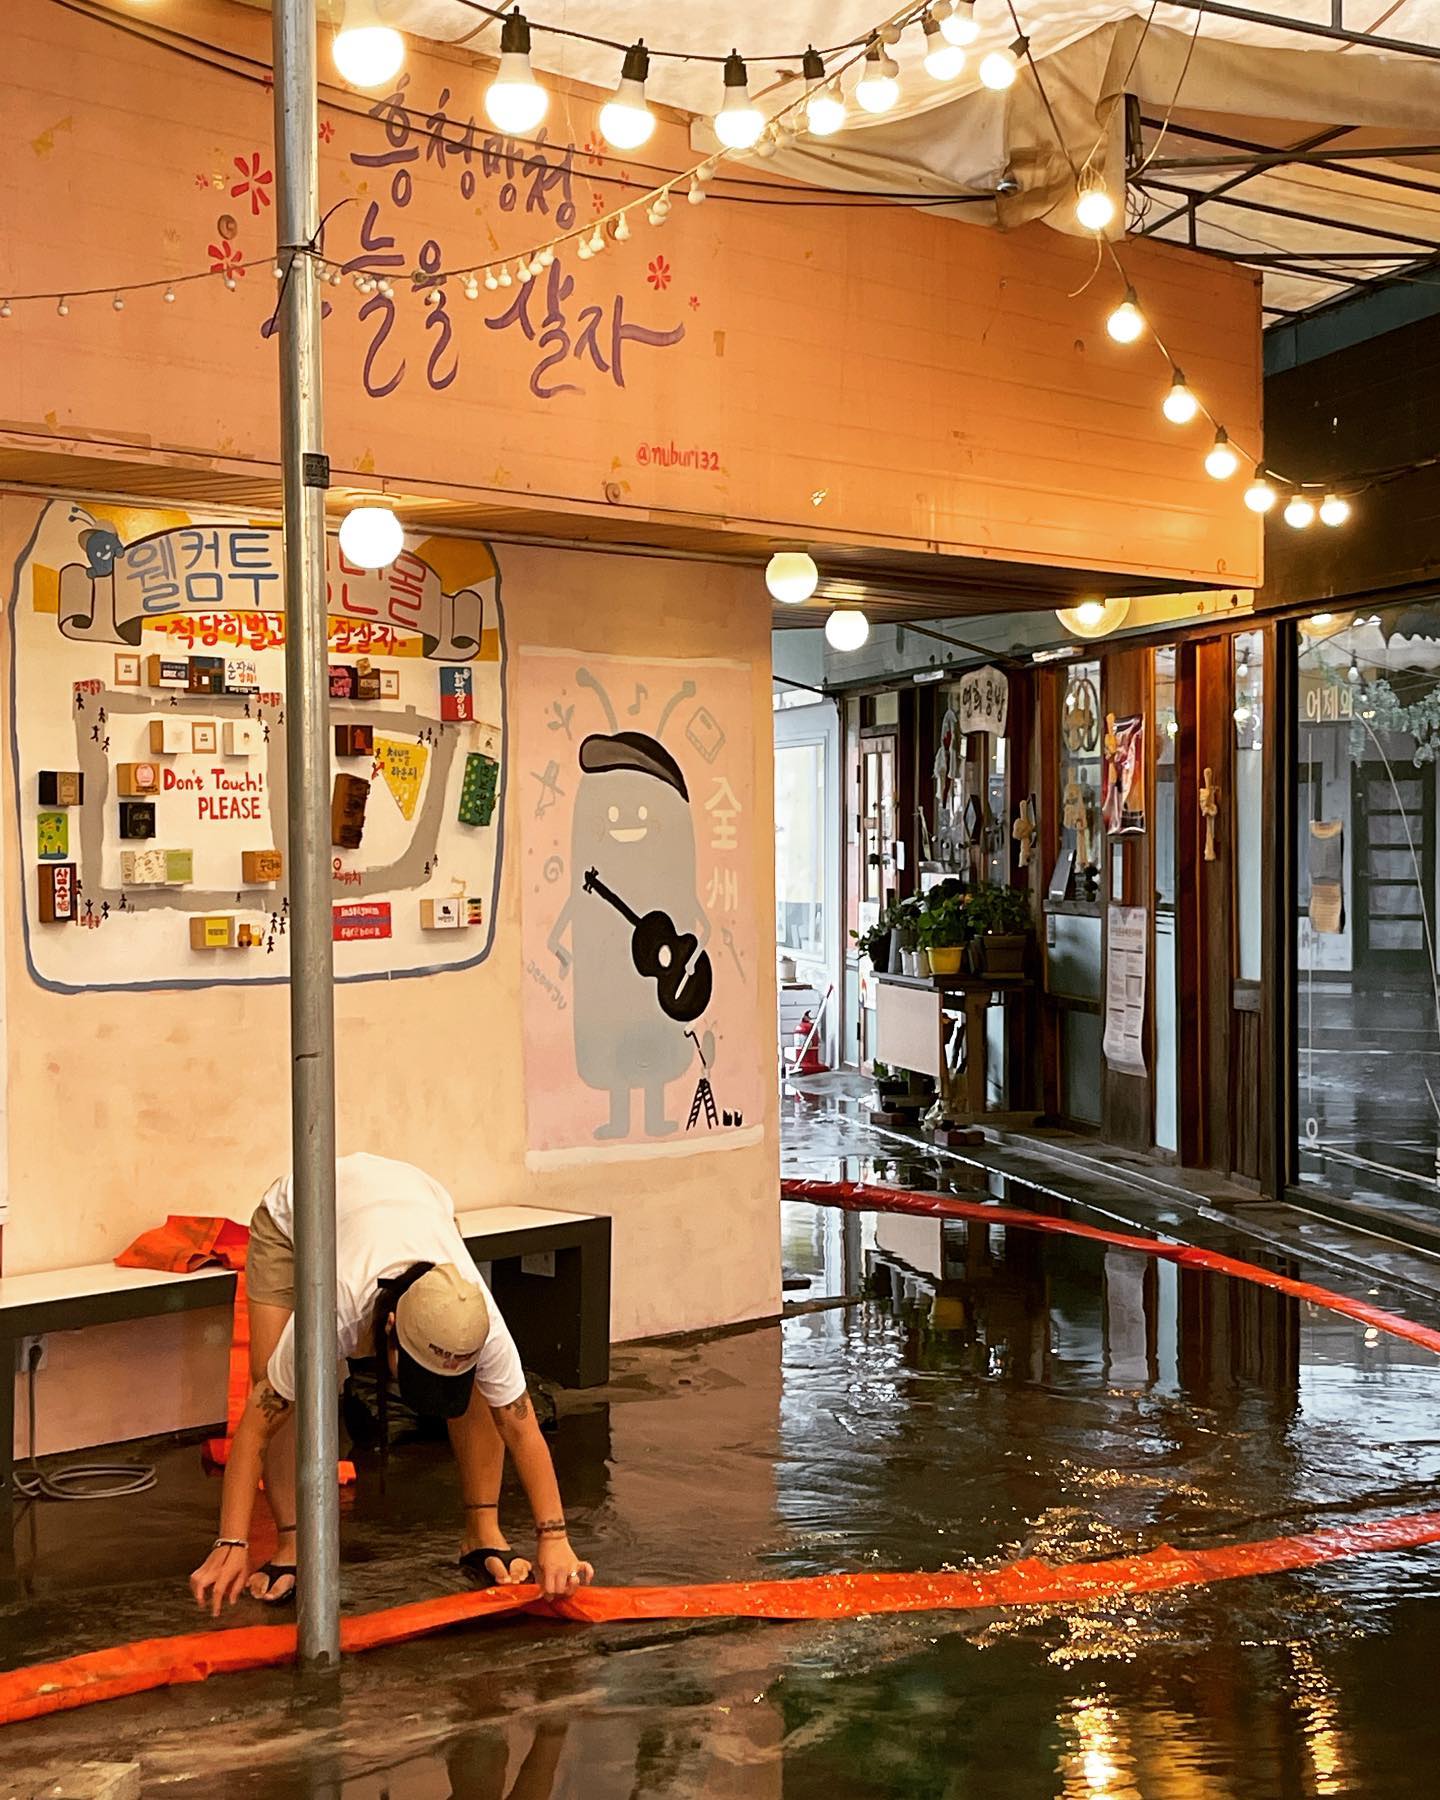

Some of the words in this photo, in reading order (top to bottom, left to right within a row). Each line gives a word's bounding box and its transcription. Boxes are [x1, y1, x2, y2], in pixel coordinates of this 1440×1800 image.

[350, 73, 577, 230] 흥청망청
[484, 250, 686, 399] 살자
[126, 530, 280, 613] 웰컴투
[1306, 686, 1354, 723] 어제와
[163, 768, 204, 791] Don't
[211, 768, 263, 792] Touch!
[198, 796, 262, 820] PLEASE
